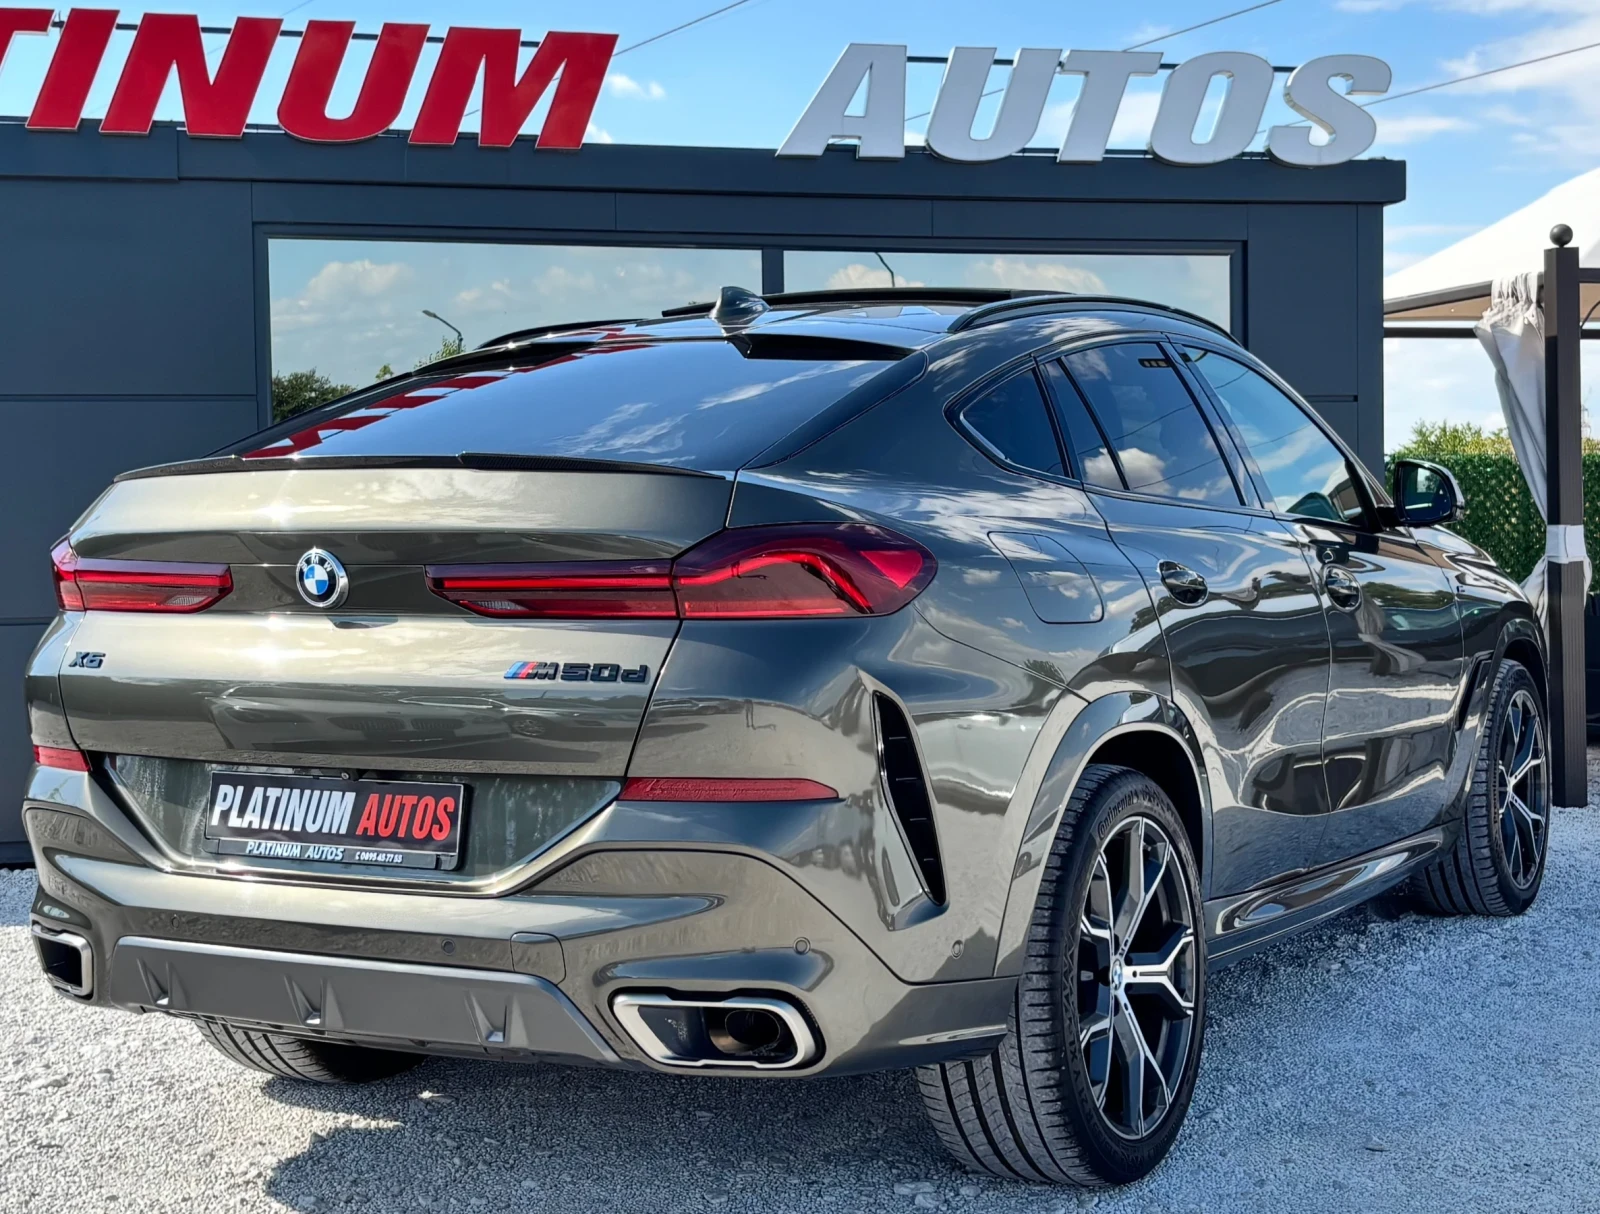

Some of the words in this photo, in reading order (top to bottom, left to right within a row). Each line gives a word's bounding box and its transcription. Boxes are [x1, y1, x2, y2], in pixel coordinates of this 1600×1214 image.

[775, 43, 1393, 167] AUTOS
[68, 651, 106, 668] X6
[211, 784, 356, 835] PLATINUM
[356, 793, 455, 841] AUTOS
[246, 841, 301, 858] PLATINUM
[305, 846, 344, 861] AUTOS
